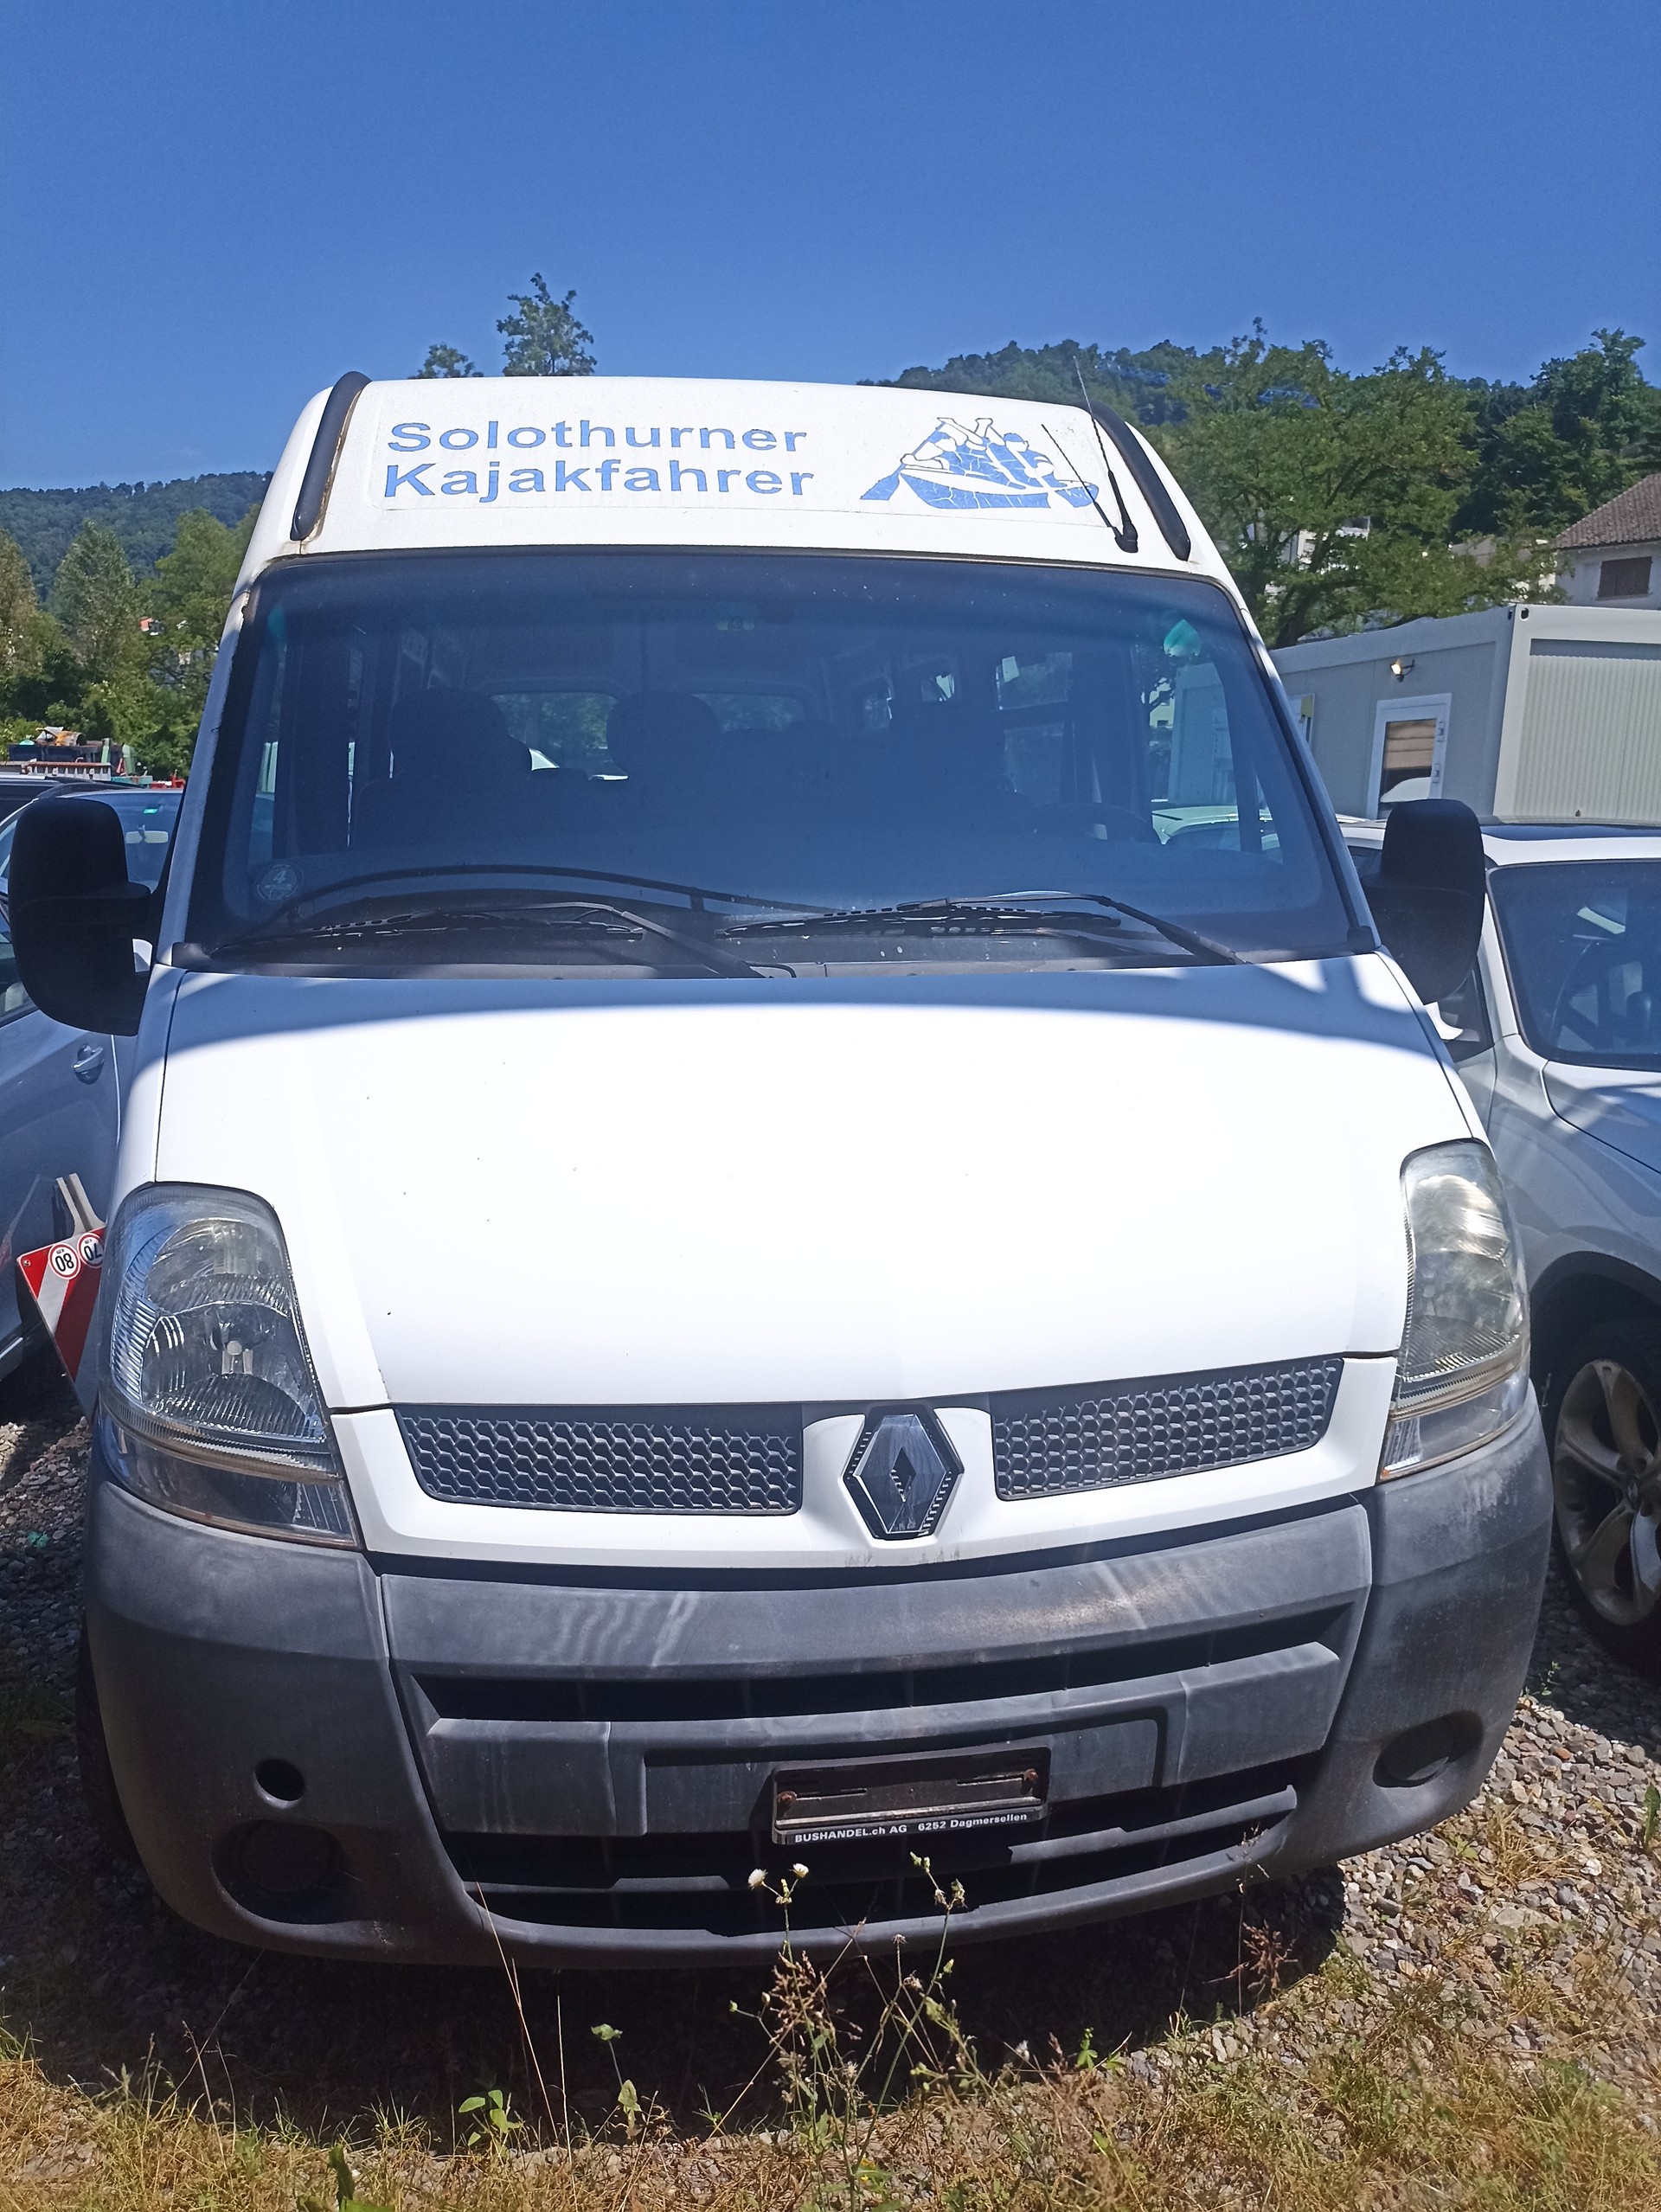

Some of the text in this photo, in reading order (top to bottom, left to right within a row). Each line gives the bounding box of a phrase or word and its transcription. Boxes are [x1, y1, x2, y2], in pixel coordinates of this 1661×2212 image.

[388, 420, 808, 452] Solothurner
[383, 458, 815, 503] Kajakfahrer
[55, 1253, 74, 1273] 80
[794, 1813, 1028, 1843] BUSHANDEL.ch AG 6252 Dagmersellen
